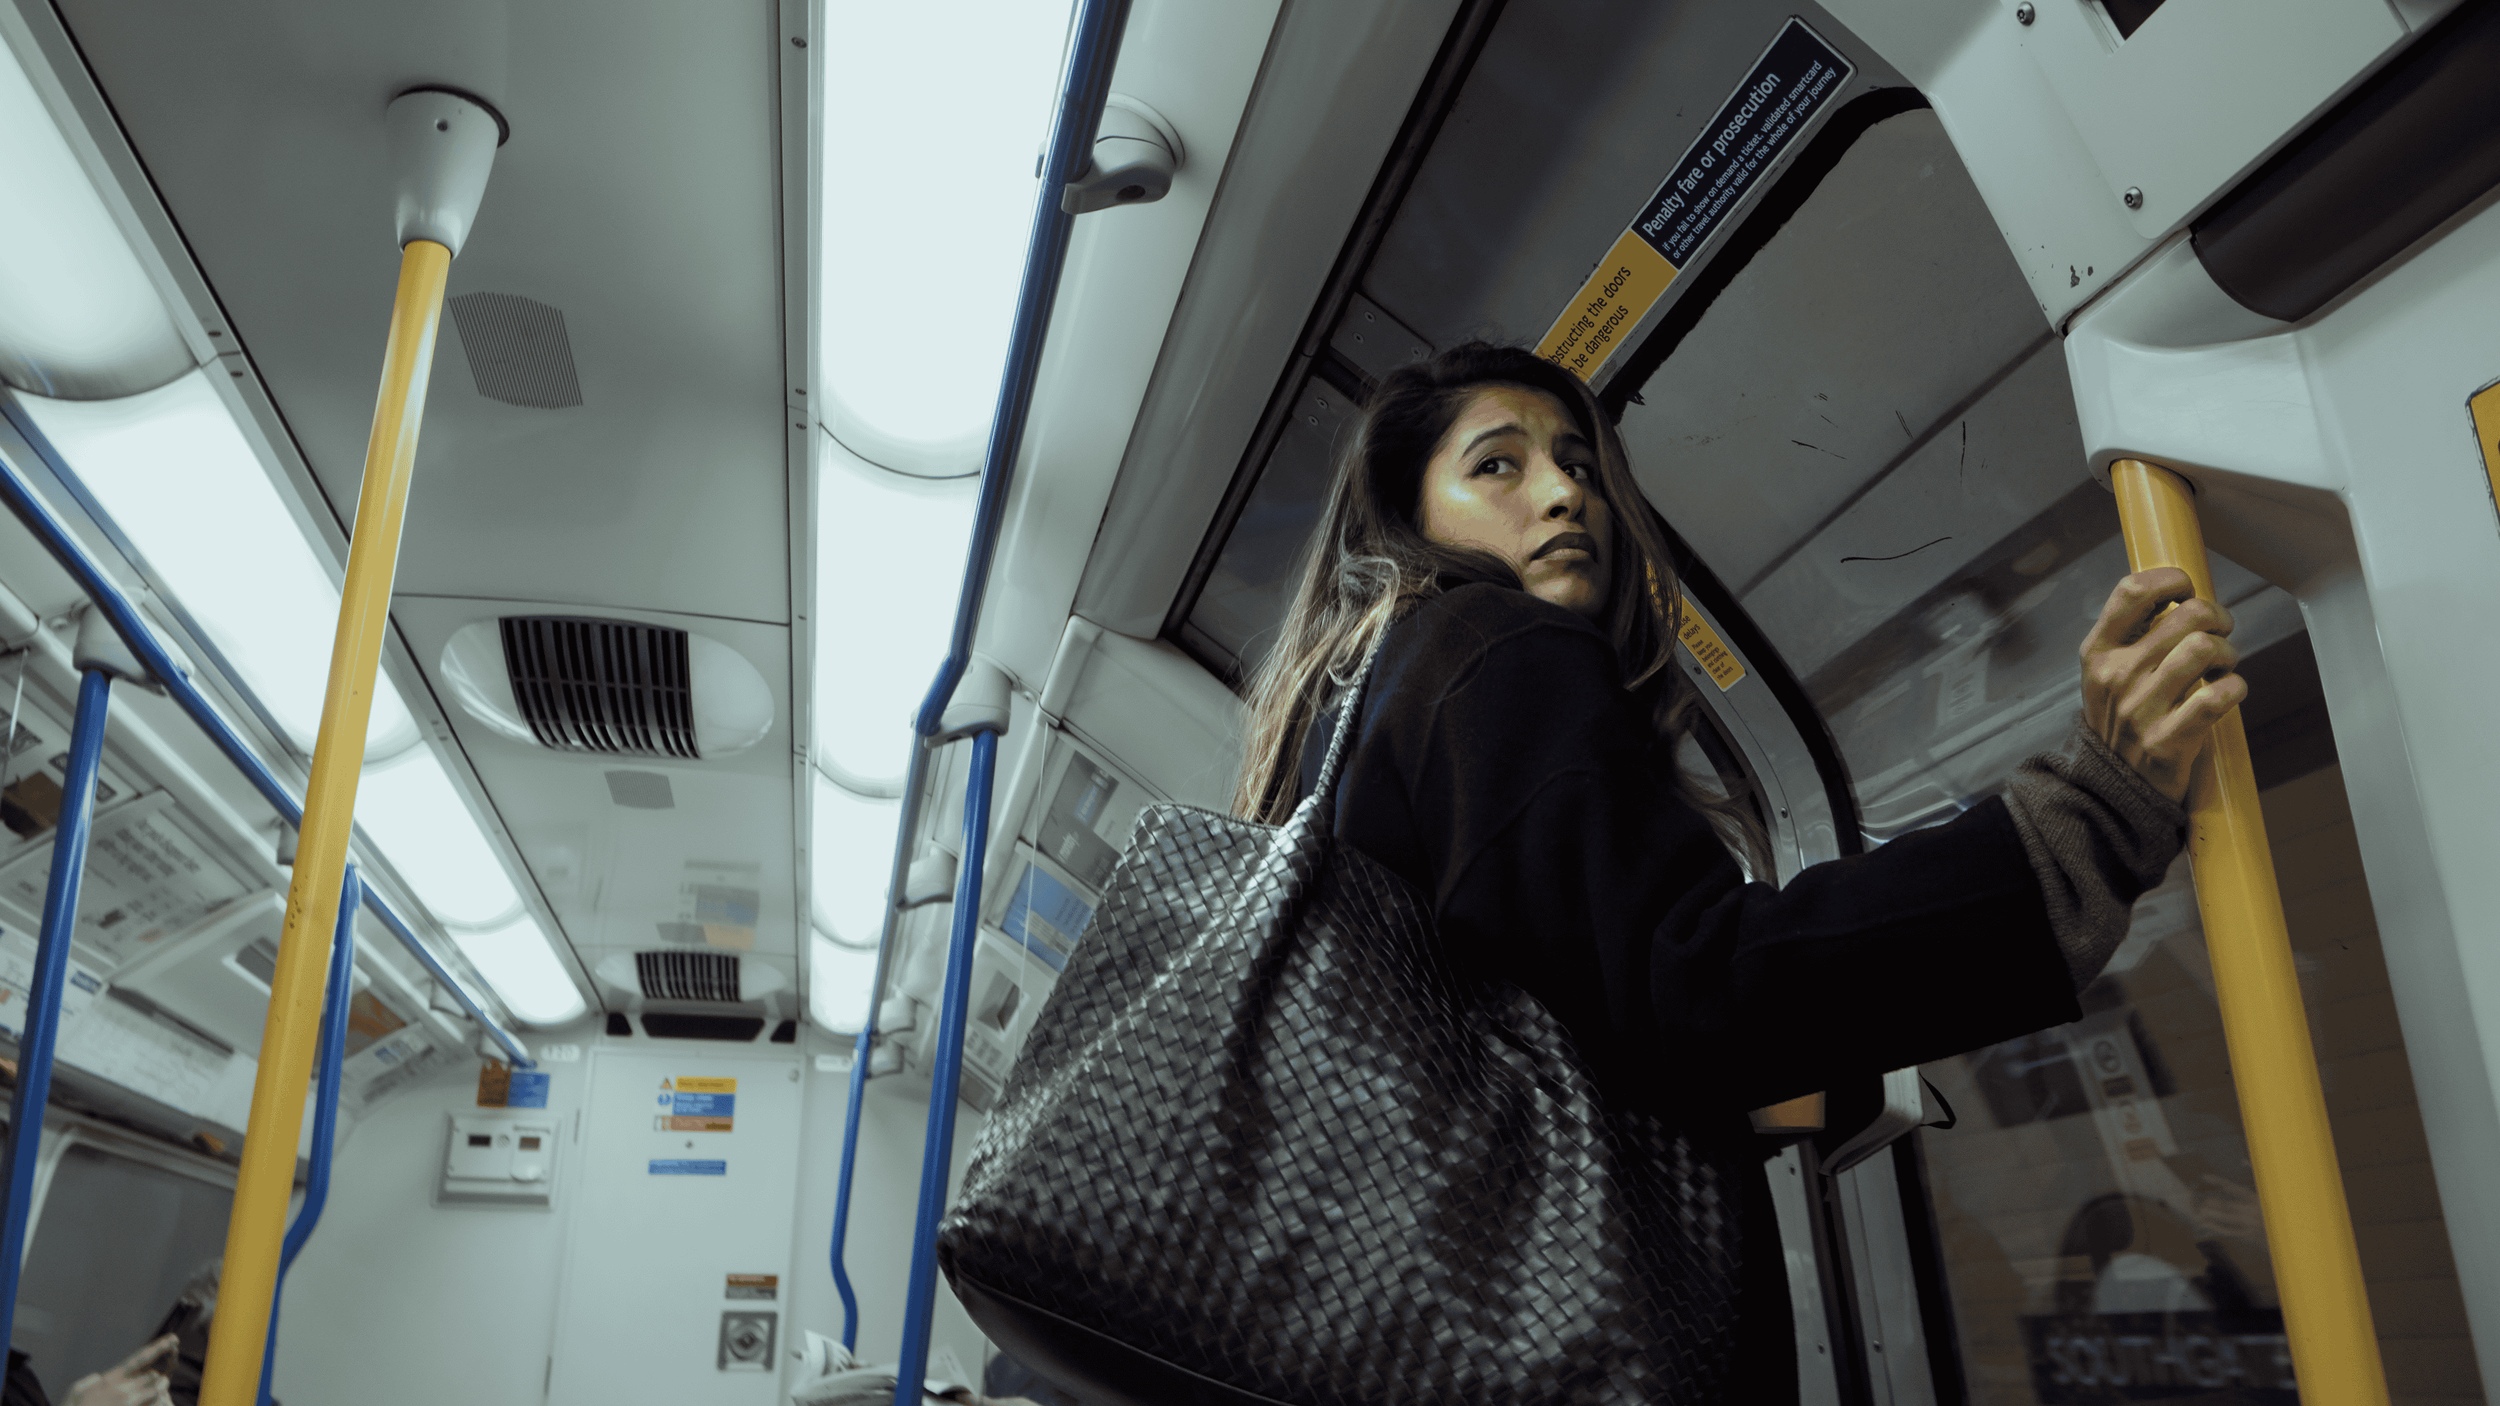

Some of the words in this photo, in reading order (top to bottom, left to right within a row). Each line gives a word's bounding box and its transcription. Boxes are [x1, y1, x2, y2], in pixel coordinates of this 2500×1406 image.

[1642, 191, 1685, 238] Penalty
[1676, 167, 1704, 194] fare
[1700, 150, 1716, 168] or
[1712, 73, 1781, 156] prosecution
[1662, 242, 1671, 251] if
[1668, 231, 1681, 247] you
[1676, 220, 1690, 234] fail
[1686, 213, 1696, 223] to
[1694, 196, 1710, 214] show
[1708, 186, 1718, 198] on
[1715, 158, 1740, 188] demand
[1741, 133, 1764, 156] ticket,
[1760, 97, 1791, 133] validated
[1788, 60, 1822, 101] smartcard
[1673, 249, 1681, 259] or
[1679, 232, 1695, 251] other
[1692, 213, 1711, 234] travel
[1708, 185, 1736, 216] authority
[1732, 167, 1749, 187] valid
[1745, 157, 1758, 171] for
[1755, 144, 1770, 159] the
[1767, 122, 1789, 146] whole
[1786, 110, 1797, 124] of
[1794, 96, 1811, 116] your
[1807, 67, 1836, 100] journey
[1571, 353, 1589, 369] be
[1584, 305, 1629, 355] dangerous
[1587, 297, 1608, 317] the
[1603, 266, 1631, 298] doors
[1683, 624, 1700, 640] delays
